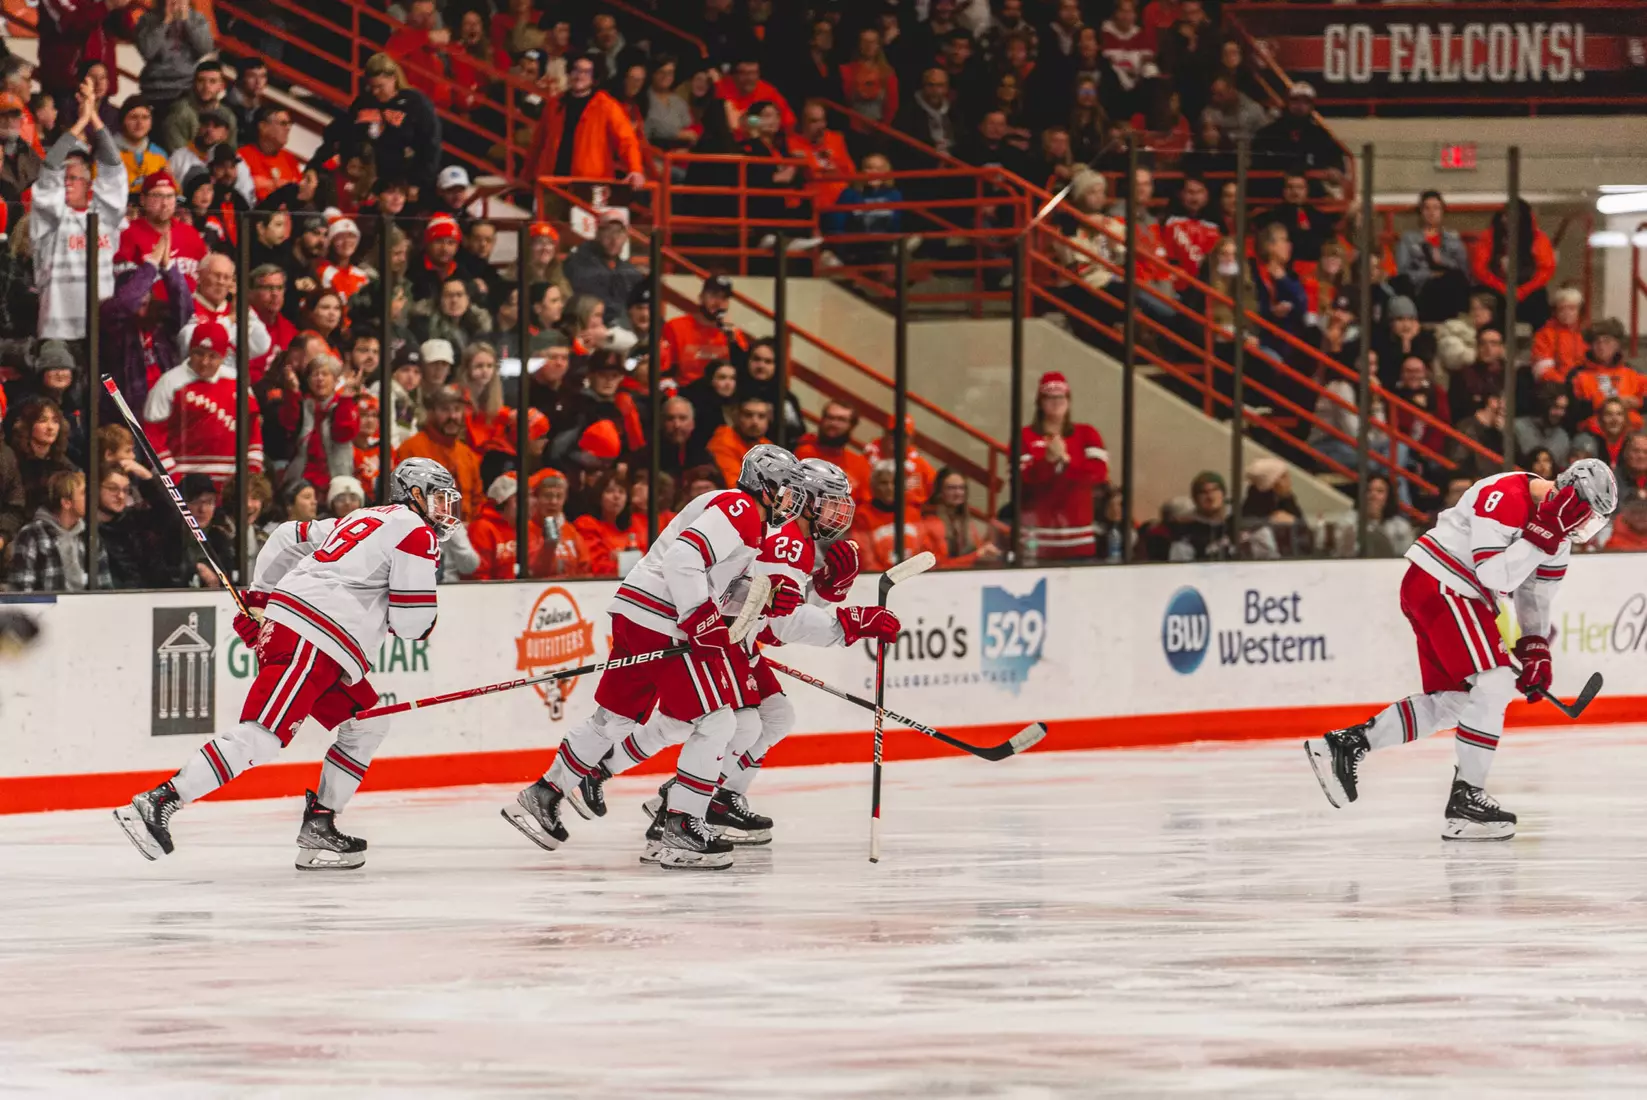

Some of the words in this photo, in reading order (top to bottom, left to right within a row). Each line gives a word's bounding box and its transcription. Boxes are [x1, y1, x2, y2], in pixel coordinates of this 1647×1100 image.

[1323, 24, 1373, 82] GO
[1386, 22, 1585, 82] FALCONS!
[160, 474, 207, 542] BAUER
[728, 498, 750, 517] 5
[1484, 491, 1504, 512] 8
[313, 516, 384, 563] 8
[774, 536, 804, 563] 23
[535, 607, 573, 630] Falcon
[1244, 590, 1302, 625] Best
[525, 628, 585, 659] OUTFITTERS
[985, 609, 1043, 657] 529
[1167, 614, 1208, 652] BW
[1218, 630, 1327, 666] Western
[594, 650, 664, 672] BAUER
[864, 670, 1018, 690] CLLEGEADVANTAGE
